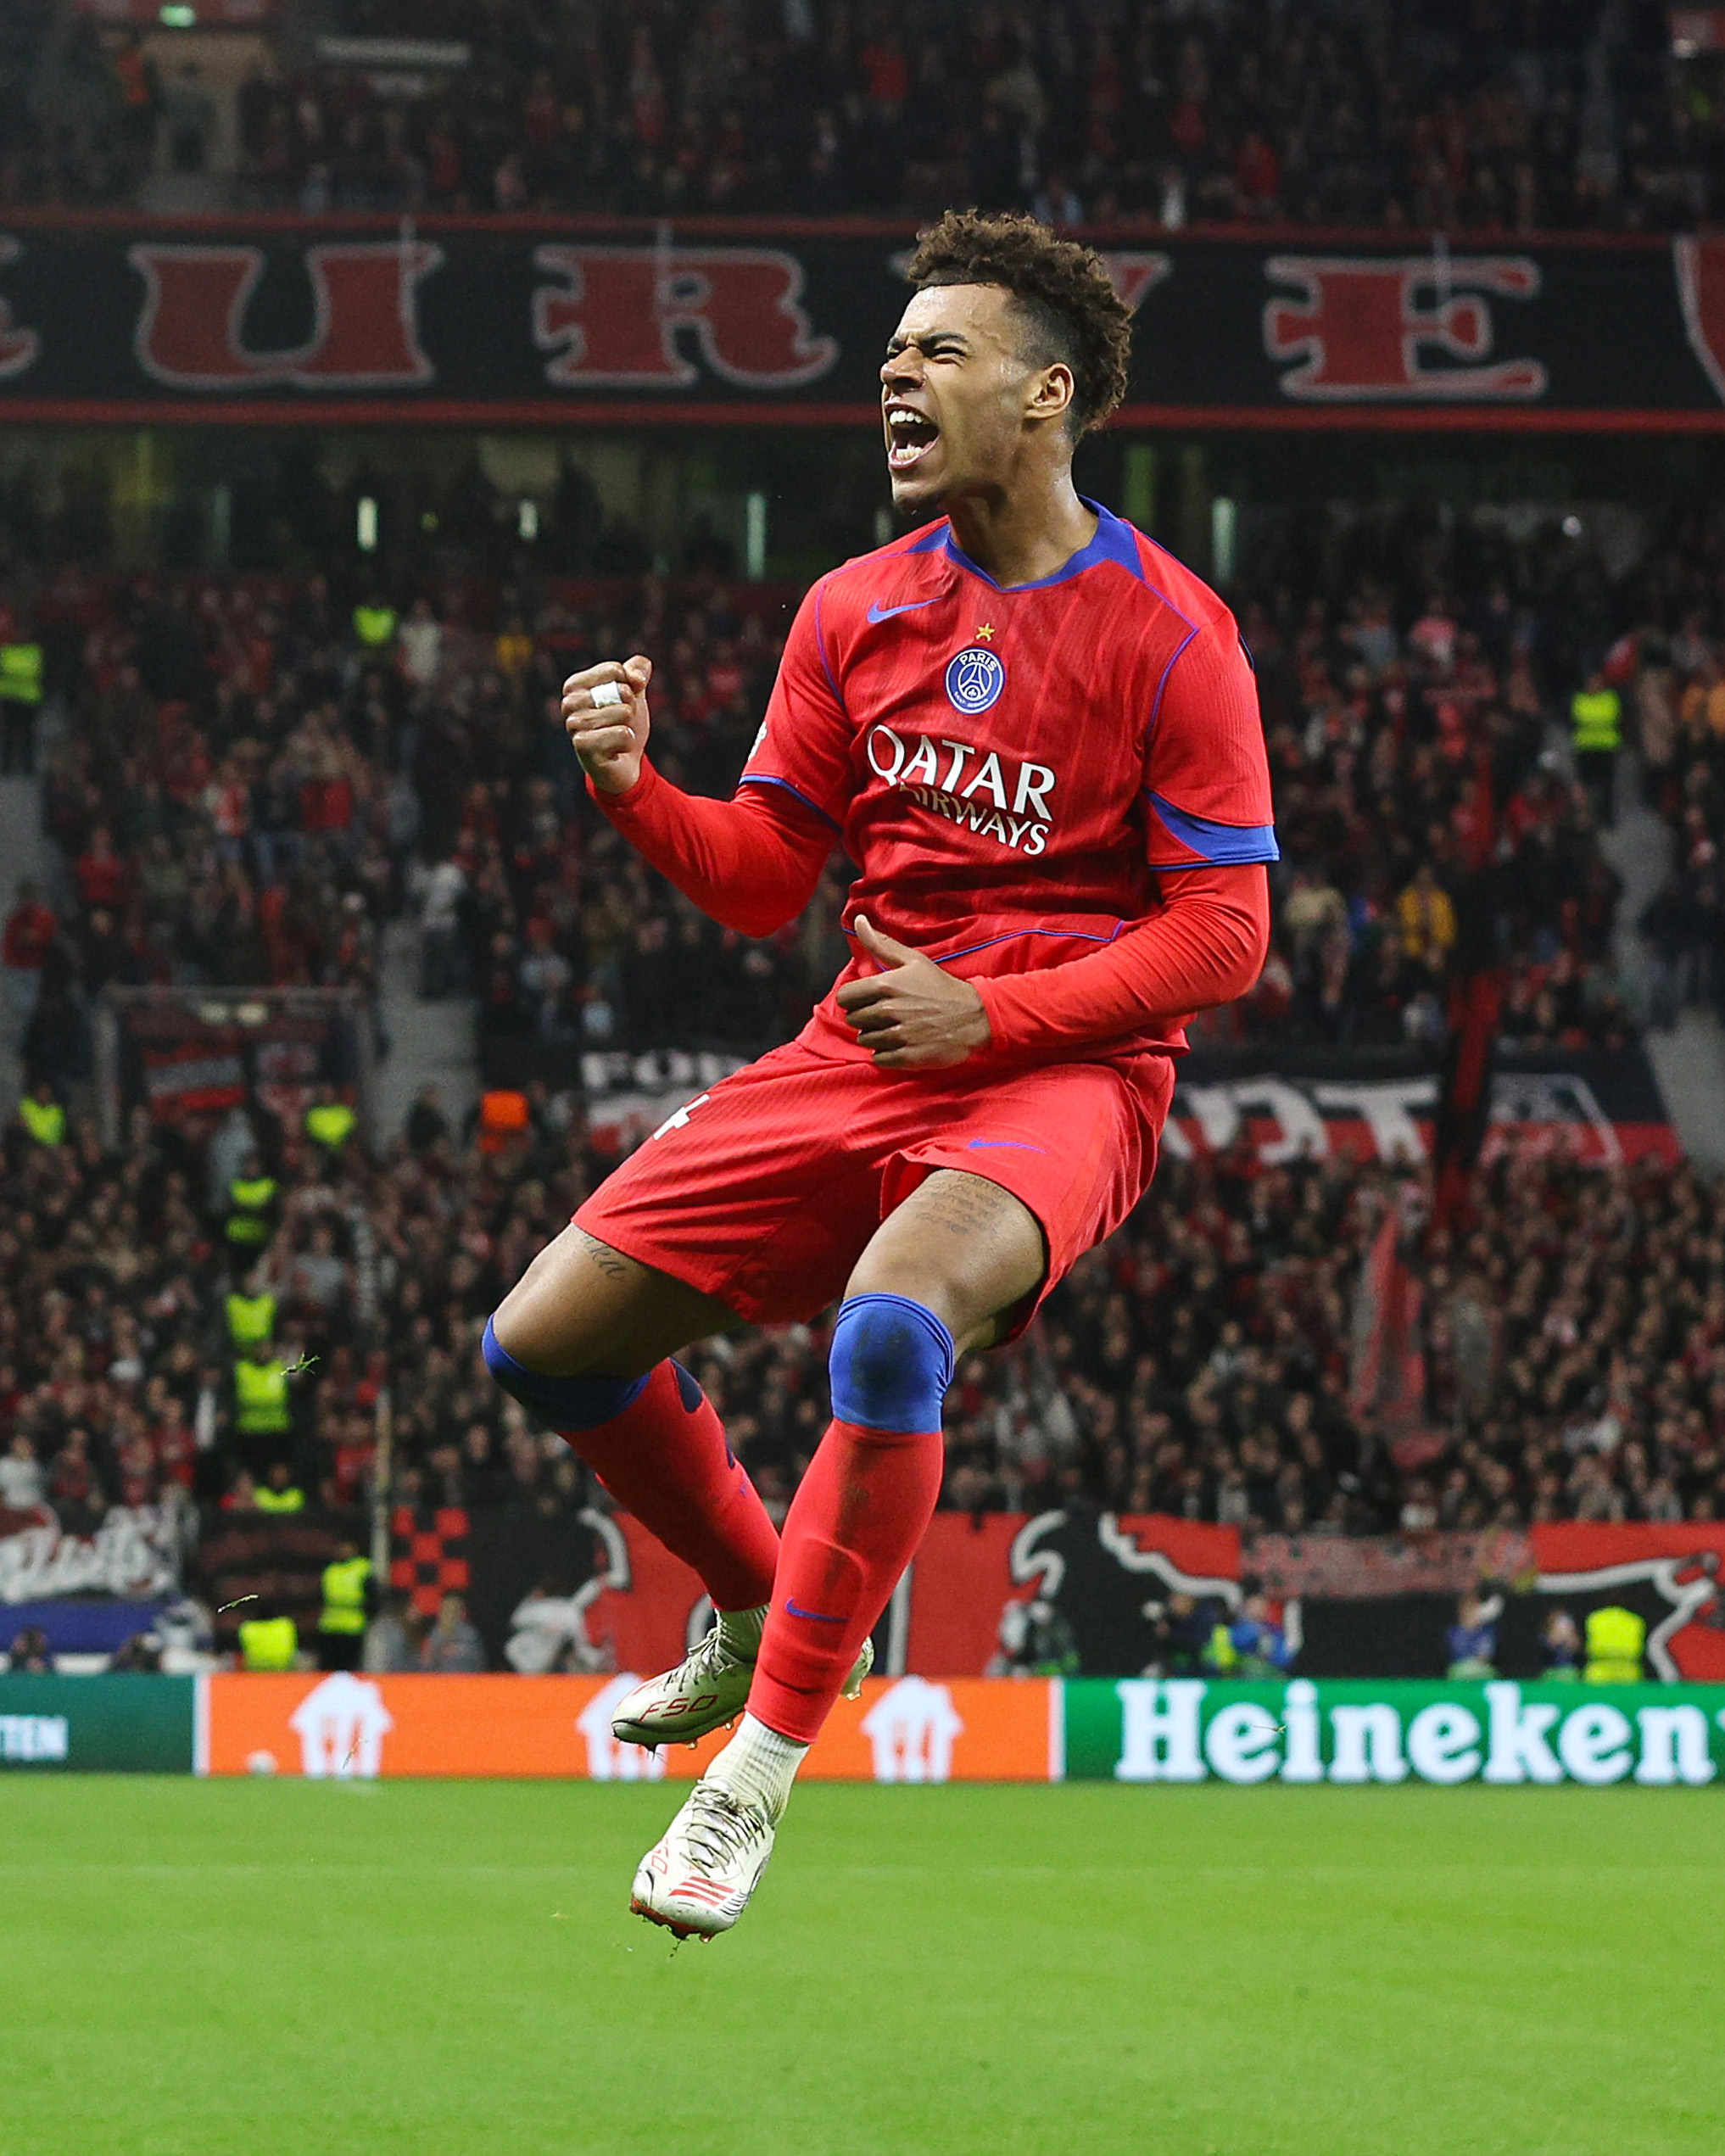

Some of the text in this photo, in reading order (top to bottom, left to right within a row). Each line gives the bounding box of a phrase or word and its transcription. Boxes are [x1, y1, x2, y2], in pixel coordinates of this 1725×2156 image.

[959, 652, 997, 672] PARIS
[867, 724, 1056, 822] QATAR
[899, 780, 1050, 855] AIRWAYS
[637, 1695, 719, 1723] F50
[1114, 1678, 1717, 1784] Heineken
